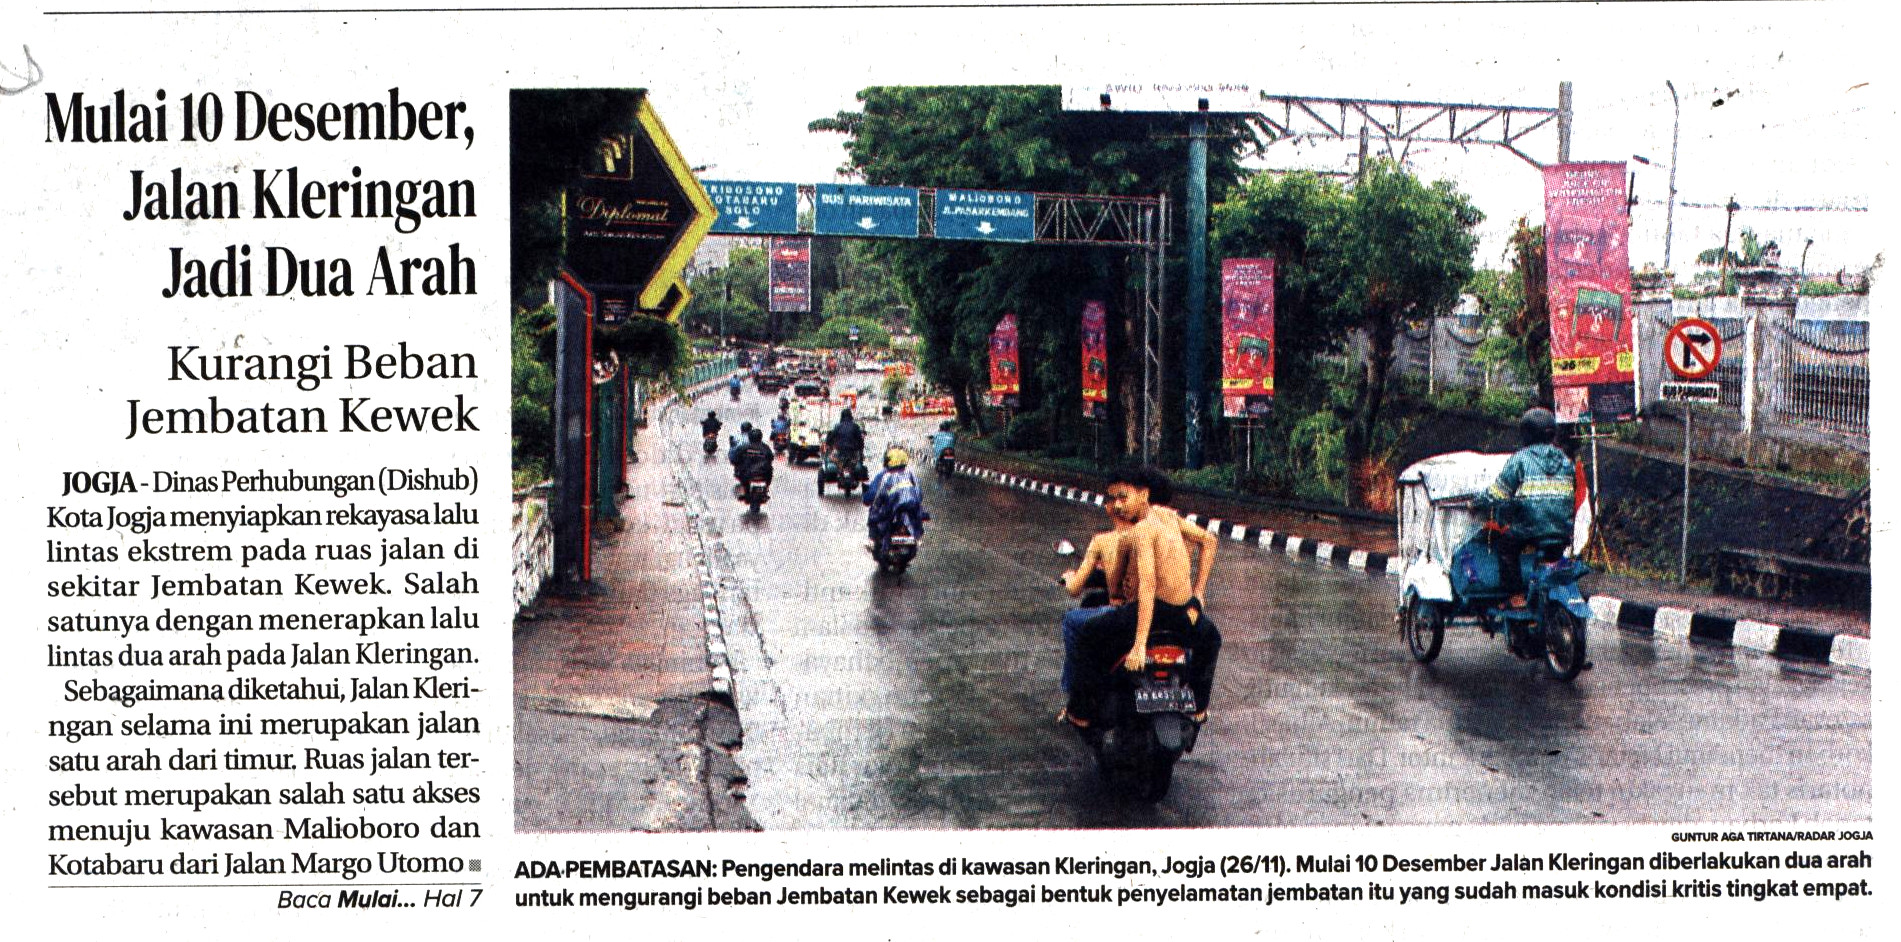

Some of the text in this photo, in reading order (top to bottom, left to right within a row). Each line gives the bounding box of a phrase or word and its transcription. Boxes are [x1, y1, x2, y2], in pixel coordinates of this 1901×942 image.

[45, 87, 474, 150] Mulai 10 Desember,
[123, 166, 476, 233] Jalan Kleringan
[577, 195, 670, 226] Diplomat
[725, 205, 761, 215] SOLO
[821, 194, 912, 208] BUS PARIWISATA
[947, 193, 1022, 204] MALIOBORO
[162, 243, 477, 298] Jadi Dua Arah
[168, 342, 478, 391] Kurangi Beban
[126, 394, 479, 439] Jembatan Kewek
[62, 471, 138, 496] JOGJA
[153, 471, 218, 492] Dinas
[222, 469, 375, 498] Perhubungan
[379, 466, 478, 496] (Dishub)
[47, 502, 479, 534] Kota Jogja menyiapkan rekayasa lalu
[47, 537, 479, 567] lintas ekstrem pada ruas jalan di
[48, 571, 479, 599] sekitar Jembatan Kewek. Salah
[48, 606, 479, 638] satunya dengan menerapkan lalu
[48, 642, 478, 672] lintas dua arah pada Jalan Kleringan.
[65, 676, 479, 707] Sebagaimana diketahui, Jalan Kleri-
[49, 711, 480, 743] ngan selama ini merupakan jalan
[49, 746, 479, 775] satu arah dari timur. Ruas jalan ter-
[49, 781, 480, 811] sebut merupakan salah satu akses
[49, 816, 480, 847] menuju kawasan Malioboro dan
[1672, 831, 1873, 841] GUNTUR AGA TIRTANA/RADAR JOGJA
[49, 852, 463, 880] Kotabaru dari Jalan Margo Utomo
[514, 850, 1871, 881] ADA PEMBATASAN: Pengendara melintas di kawasan Kleringan, Jogja (26/11). Mulai 10 Desember Jalan Kleringan diberlakukan dua arah
[278, 889, 483, 908] Baca Mulai... Hal 7
[516, 879, 1872, 910] untuk mengurangi beban Jembatan Kewek sebagai bentuk penyelamatan jembatan itu yang sudah masuk kondisi kritis tingkat empat.
